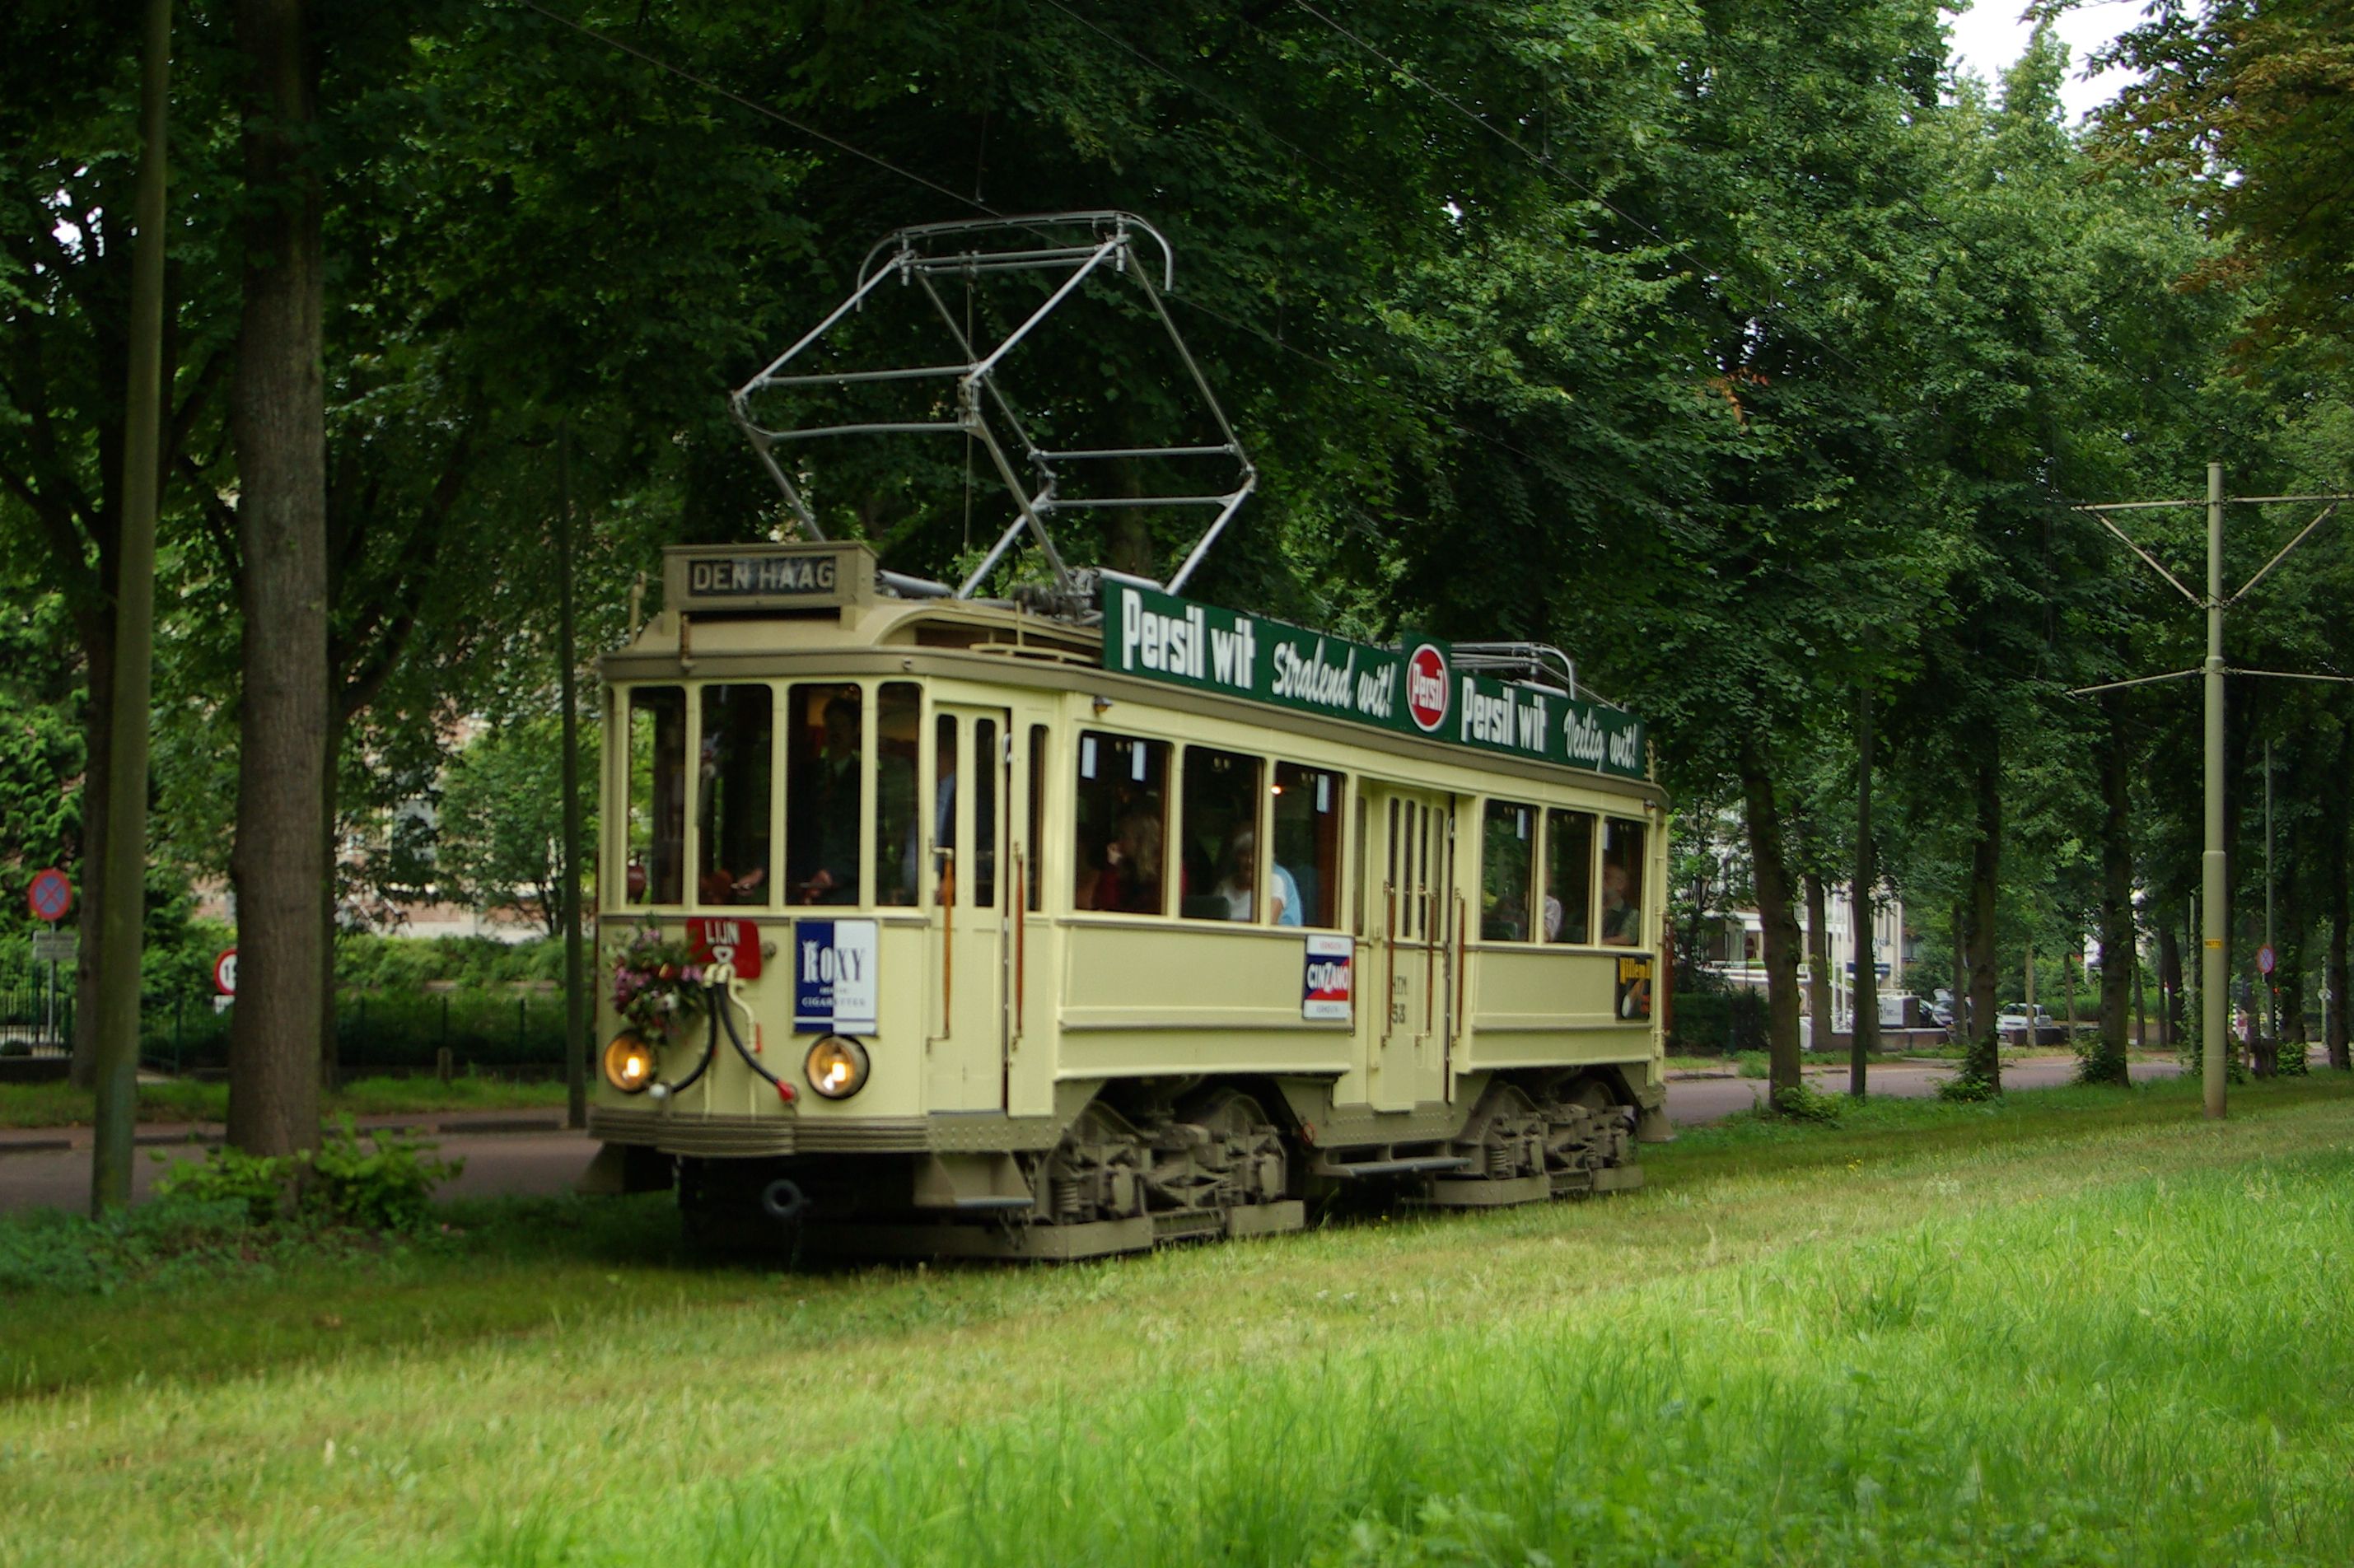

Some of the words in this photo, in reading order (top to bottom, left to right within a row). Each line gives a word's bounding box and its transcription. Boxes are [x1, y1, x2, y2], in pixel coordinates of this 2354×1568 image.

[694, 564, 749, 590] DEN
[759, 561, 834, 590] HAAG
[1121, 588, 1205, 680] Persil
[1211, 617, 1255, 688] wit
[1357, 661, 1398, 718] wit!
[1412, 663, 1443, 712] Persil
[1460, 676, 1515, 748] Persil
[1517, 693, 1547, 753] wit
[1609, 722, 1637, 768] wit!
[705, 921, 740, 945] LIJN
[801, 945, 864, 983] ROXY
[1307, 961, 1348, 993] CINZANO
